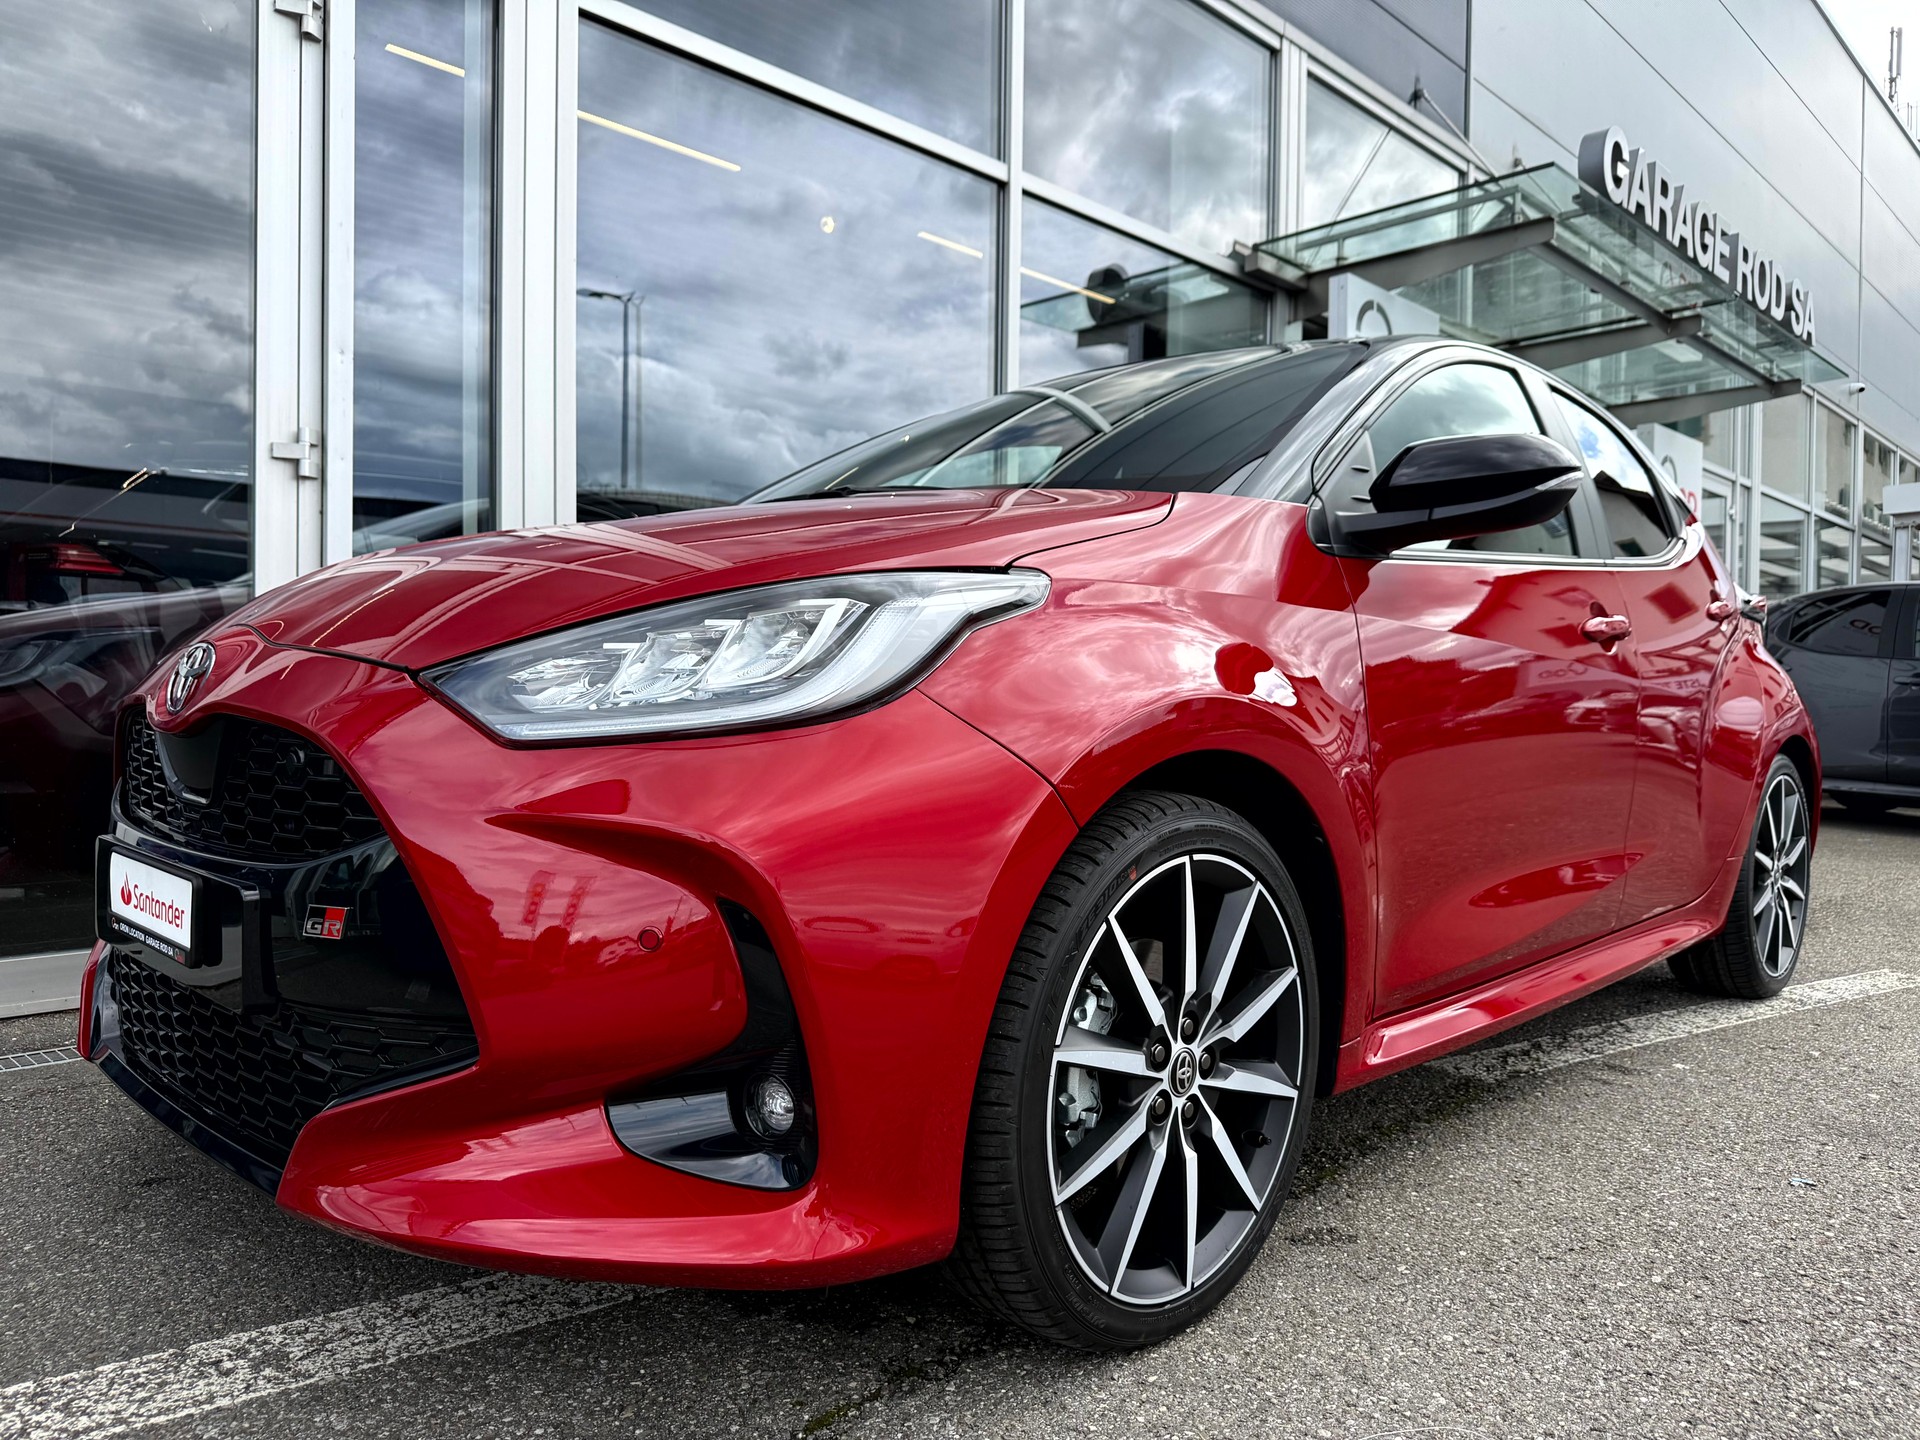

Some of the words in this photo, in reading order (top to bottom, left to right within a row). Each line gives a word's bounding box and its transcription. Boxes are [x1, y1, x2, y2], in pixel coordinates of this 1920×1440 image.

[1602, 125, 1732, 284] GARAGE
[1736, 232, 1786, 322] ROD
[1790, 277, 1816, 347] SA
[133, 883, 185, 930] Santander
[306, 917, 341, 936] GR
